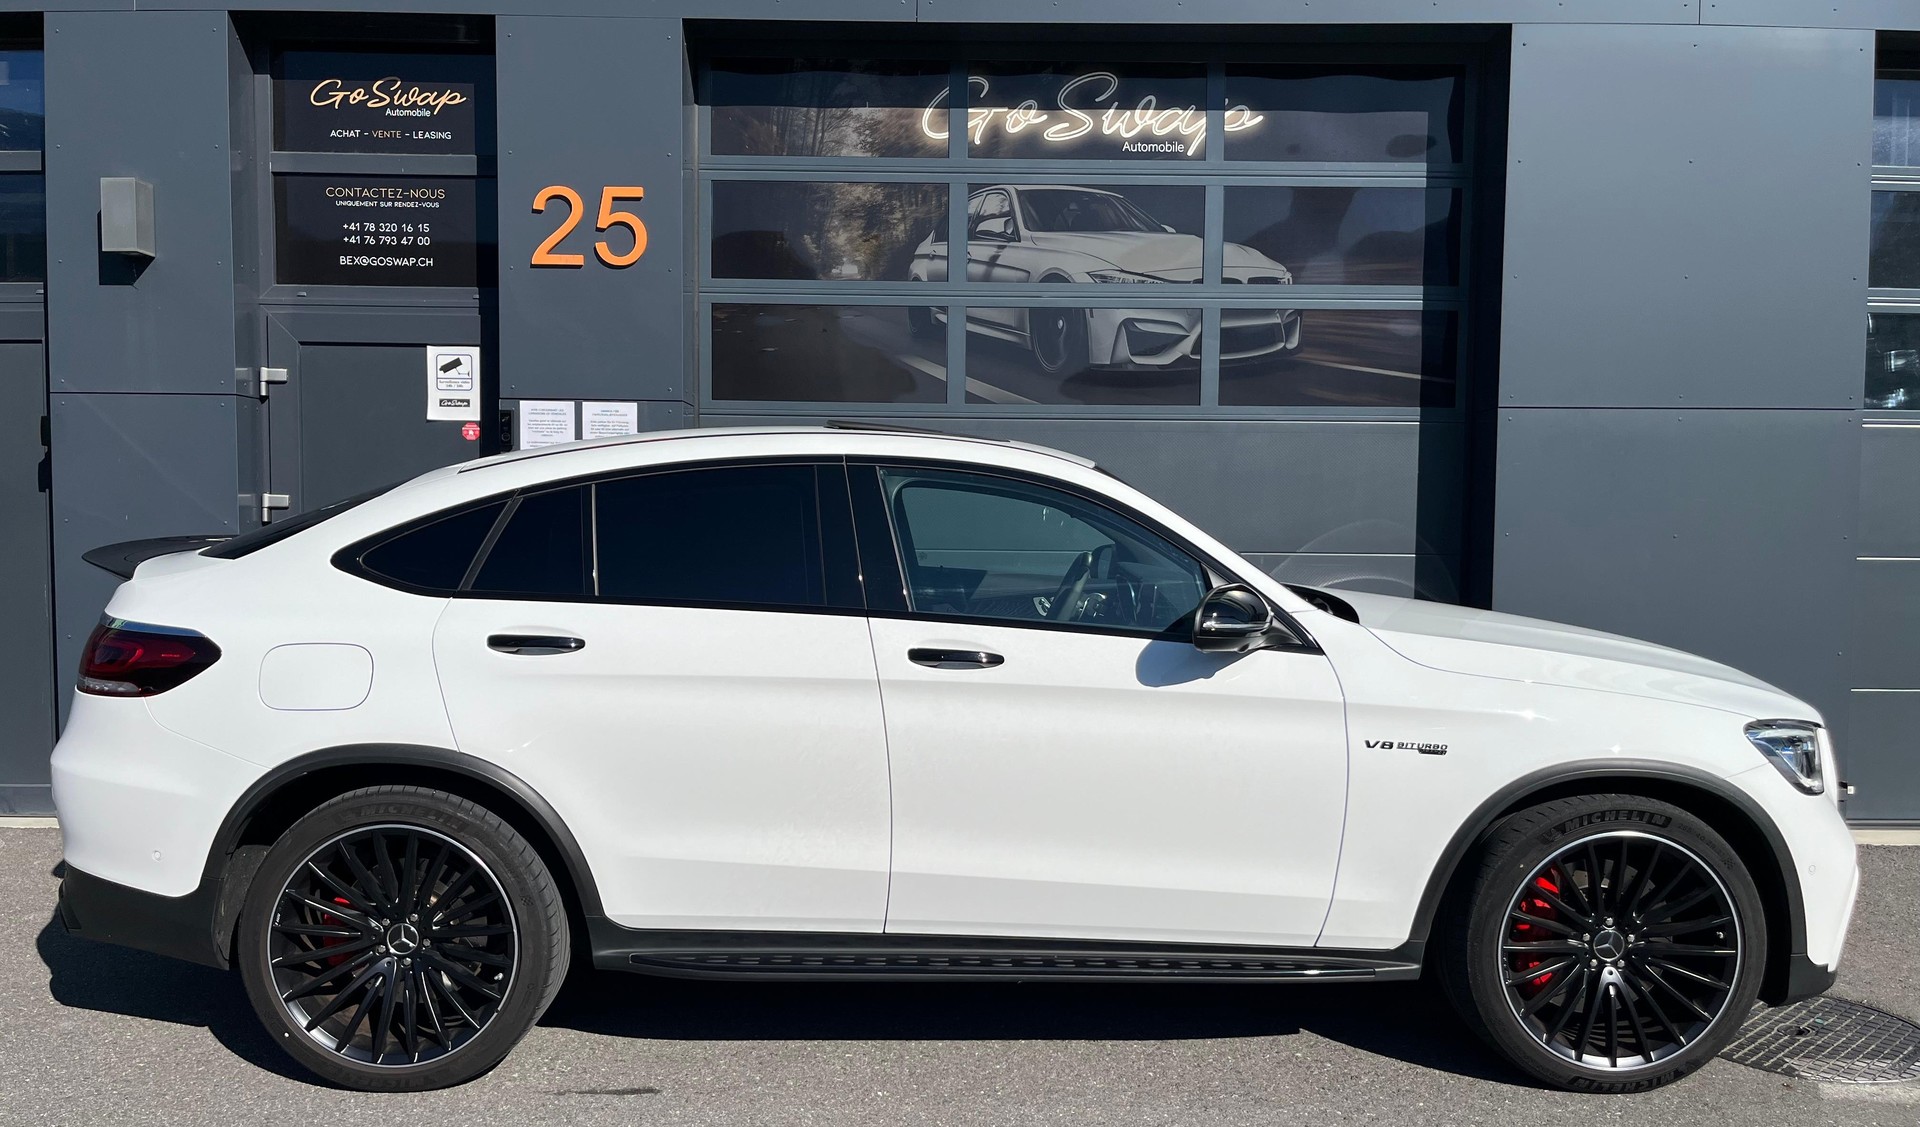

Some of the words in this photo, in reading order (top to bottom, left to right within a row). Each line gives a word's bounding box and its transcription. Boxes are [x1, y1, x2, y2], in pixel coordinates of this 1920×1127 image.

[385, 107, 431, 117] Automobile
[329, 129, 361, 138] ACHAT
[371, 130, 402, 139] VENTE
[412, 130, 452, 140] LEASING
[1122, 140, 1185, 153] Automobile
[325, 187, 446, 199] CONTACTEZ-NOUS
[335, 200, 378, 208] UNIQUEMENT
[393, 201, 440, 209] RENDEZ-VOUS
[342, 222, 360, 232] +41
[363, 222, 376, 232] 78
[378, 223, 398, 233] 320
[401, 223, 414, 233] 16
[417, 223, 430, 233] 15
[530, 185, 648, 267] 25
[343, 235, 361, 245] +41
[363, 235, 376, 245] 76
[378, 236, 398, 246] 793
[400, 236, 414, 246] 47
[417, 236, 431, 246] 00
[339, 255, 434, 267] BEX@GOSWAP.CH
[1364, 739, 1395, 750] V8
[1396, 741, 1449, 751] BITURBO
[1563, 809, 1668, 833] MICHELIN
